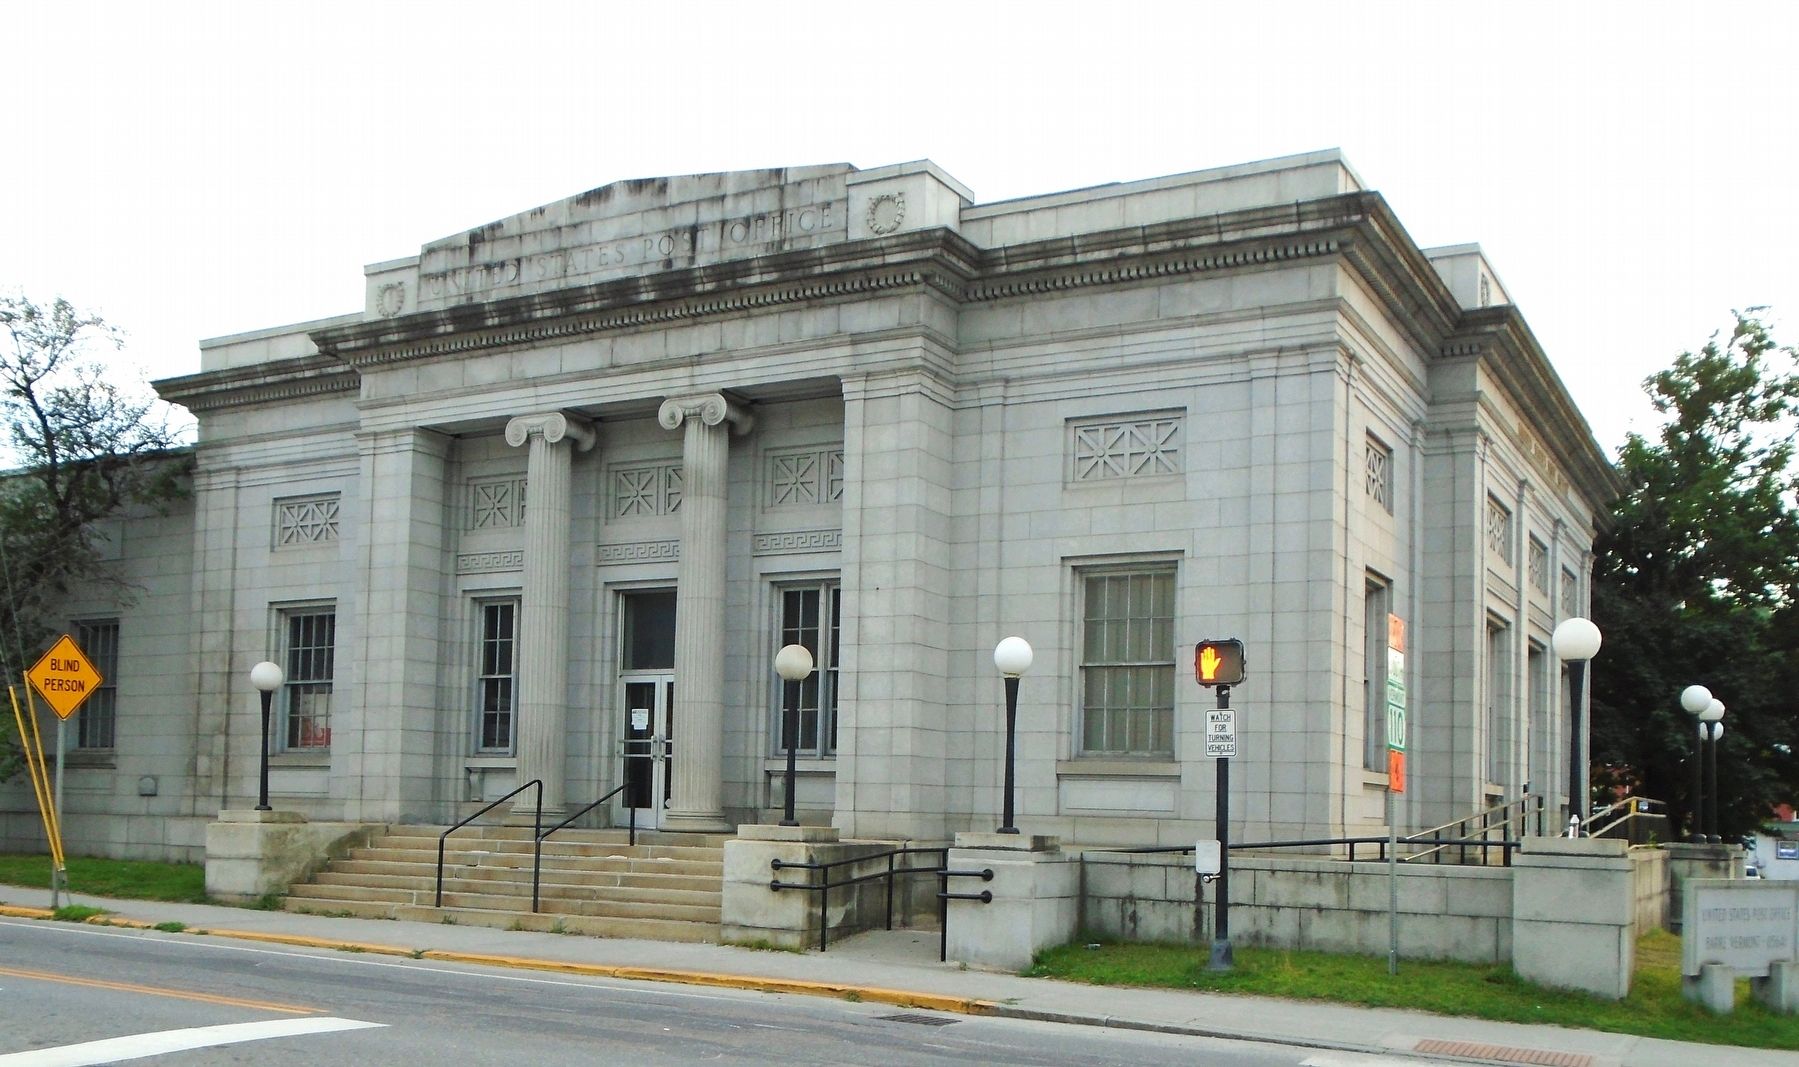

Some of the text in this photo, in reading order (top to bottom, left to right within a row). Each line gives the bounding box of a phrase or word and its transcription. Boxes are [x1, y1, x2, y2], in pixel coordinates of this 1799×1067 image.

[430, 206, 832, 295] UNITED STATES POST OFFICE
[50, 658, 80, 672] BLIND
[44, 678, 85, 692] PERSON
[1210, 713, 1231, 721] WATCH
[1389, 708, 1404, 745] 110
